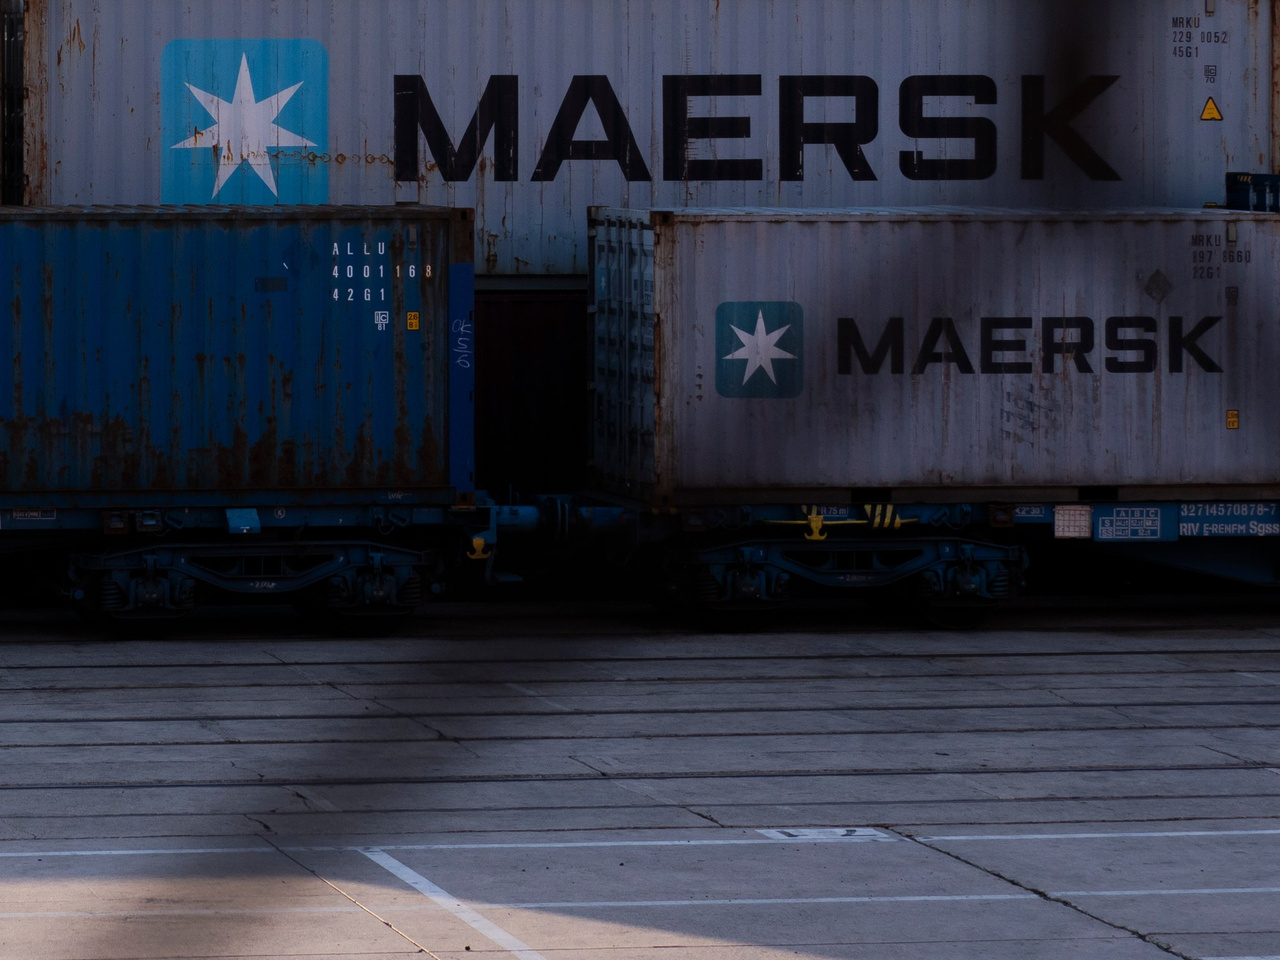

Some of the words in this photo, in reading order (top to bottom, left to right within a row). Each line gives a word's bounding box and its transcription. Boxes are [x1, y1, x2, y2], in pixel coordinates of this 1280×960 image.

[1172, 17, 1199, 28] MRKU
[1173, 31, 1191, 43] 229
[1201, 31, 1227, 43] 0052
[1173, 46, 1198, 57] 45G1
[393, 72, 1122, 181] MAERSK
[1191, 234, 1220, 246] MRKU
[332, 242, 385, 255] ALLU
[332, 288, 384, 301] 42G1
[837, 316, 1224, 374] MAERSK
[1179, 522, 1200, 536] RIV
[1249, 520, 1280, 537] Sgss
